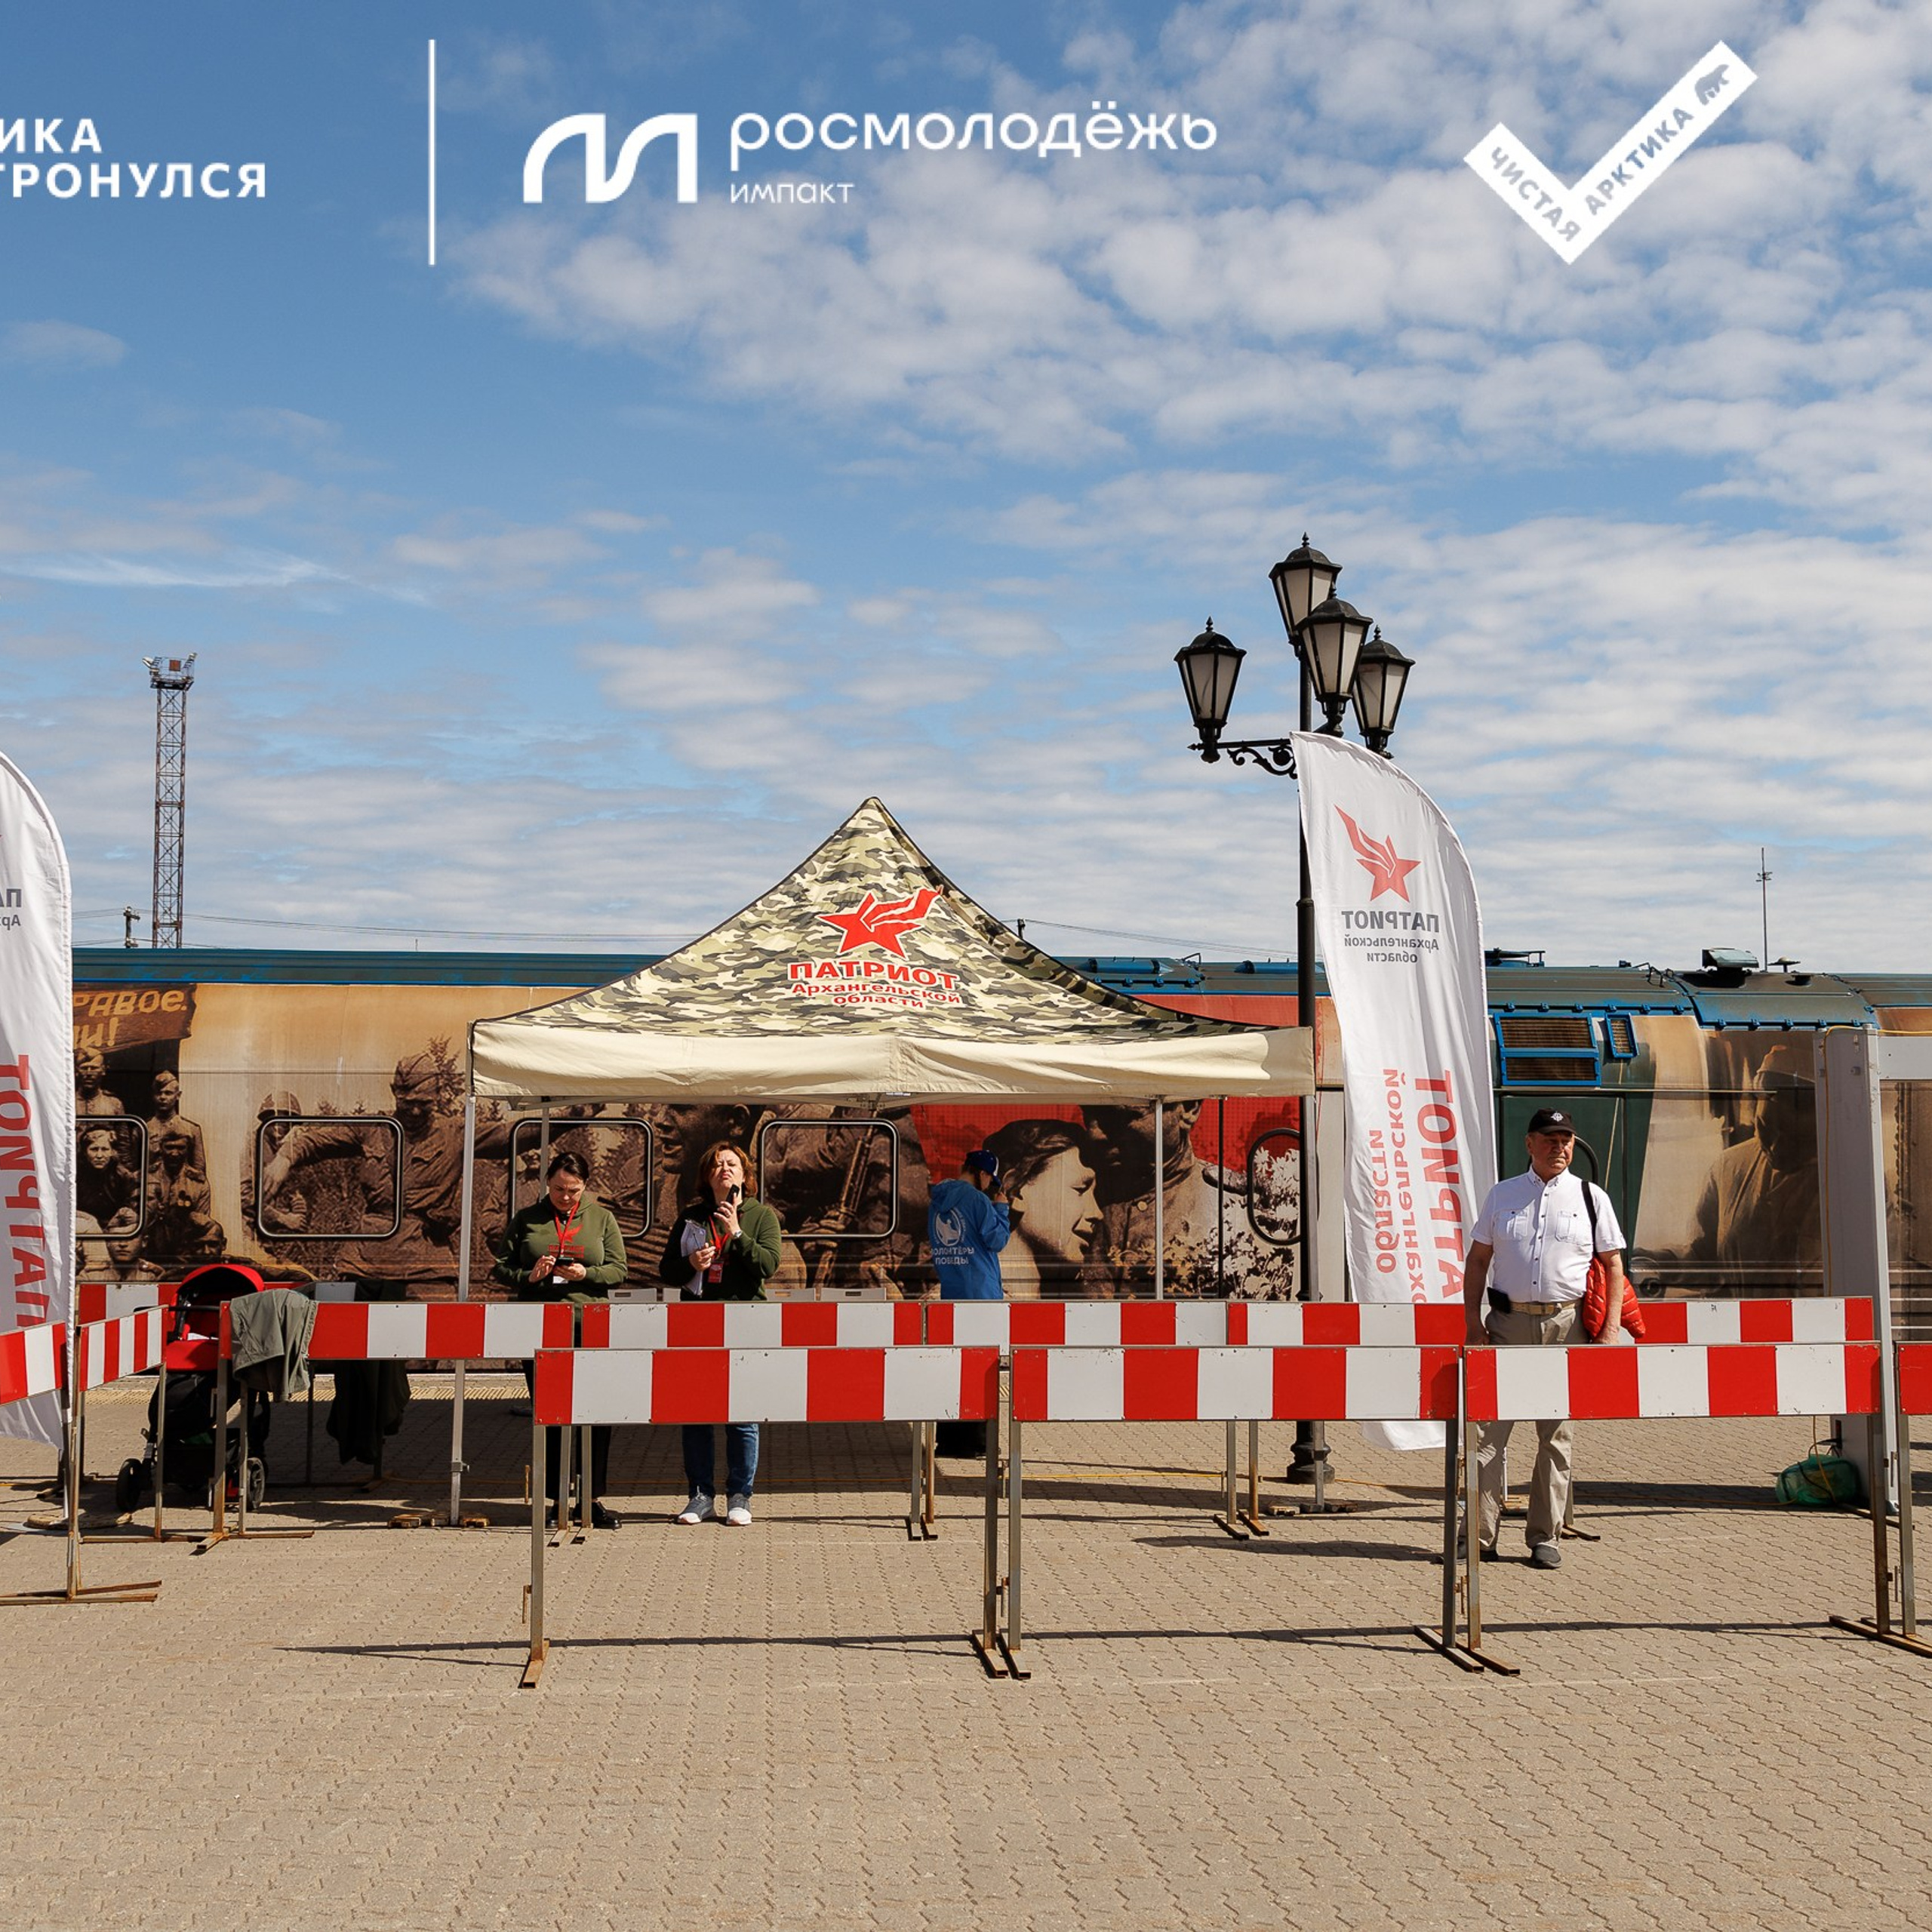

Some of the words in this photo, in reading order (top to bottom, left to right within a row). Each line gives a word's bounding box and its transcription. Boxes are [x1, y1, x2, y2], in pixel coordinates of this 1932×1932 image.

[789, 961, 958, 990] ПАТРИОТ
[792, 983, 961, 1004] Архангельской
[833, 994, 924, 1008] области
